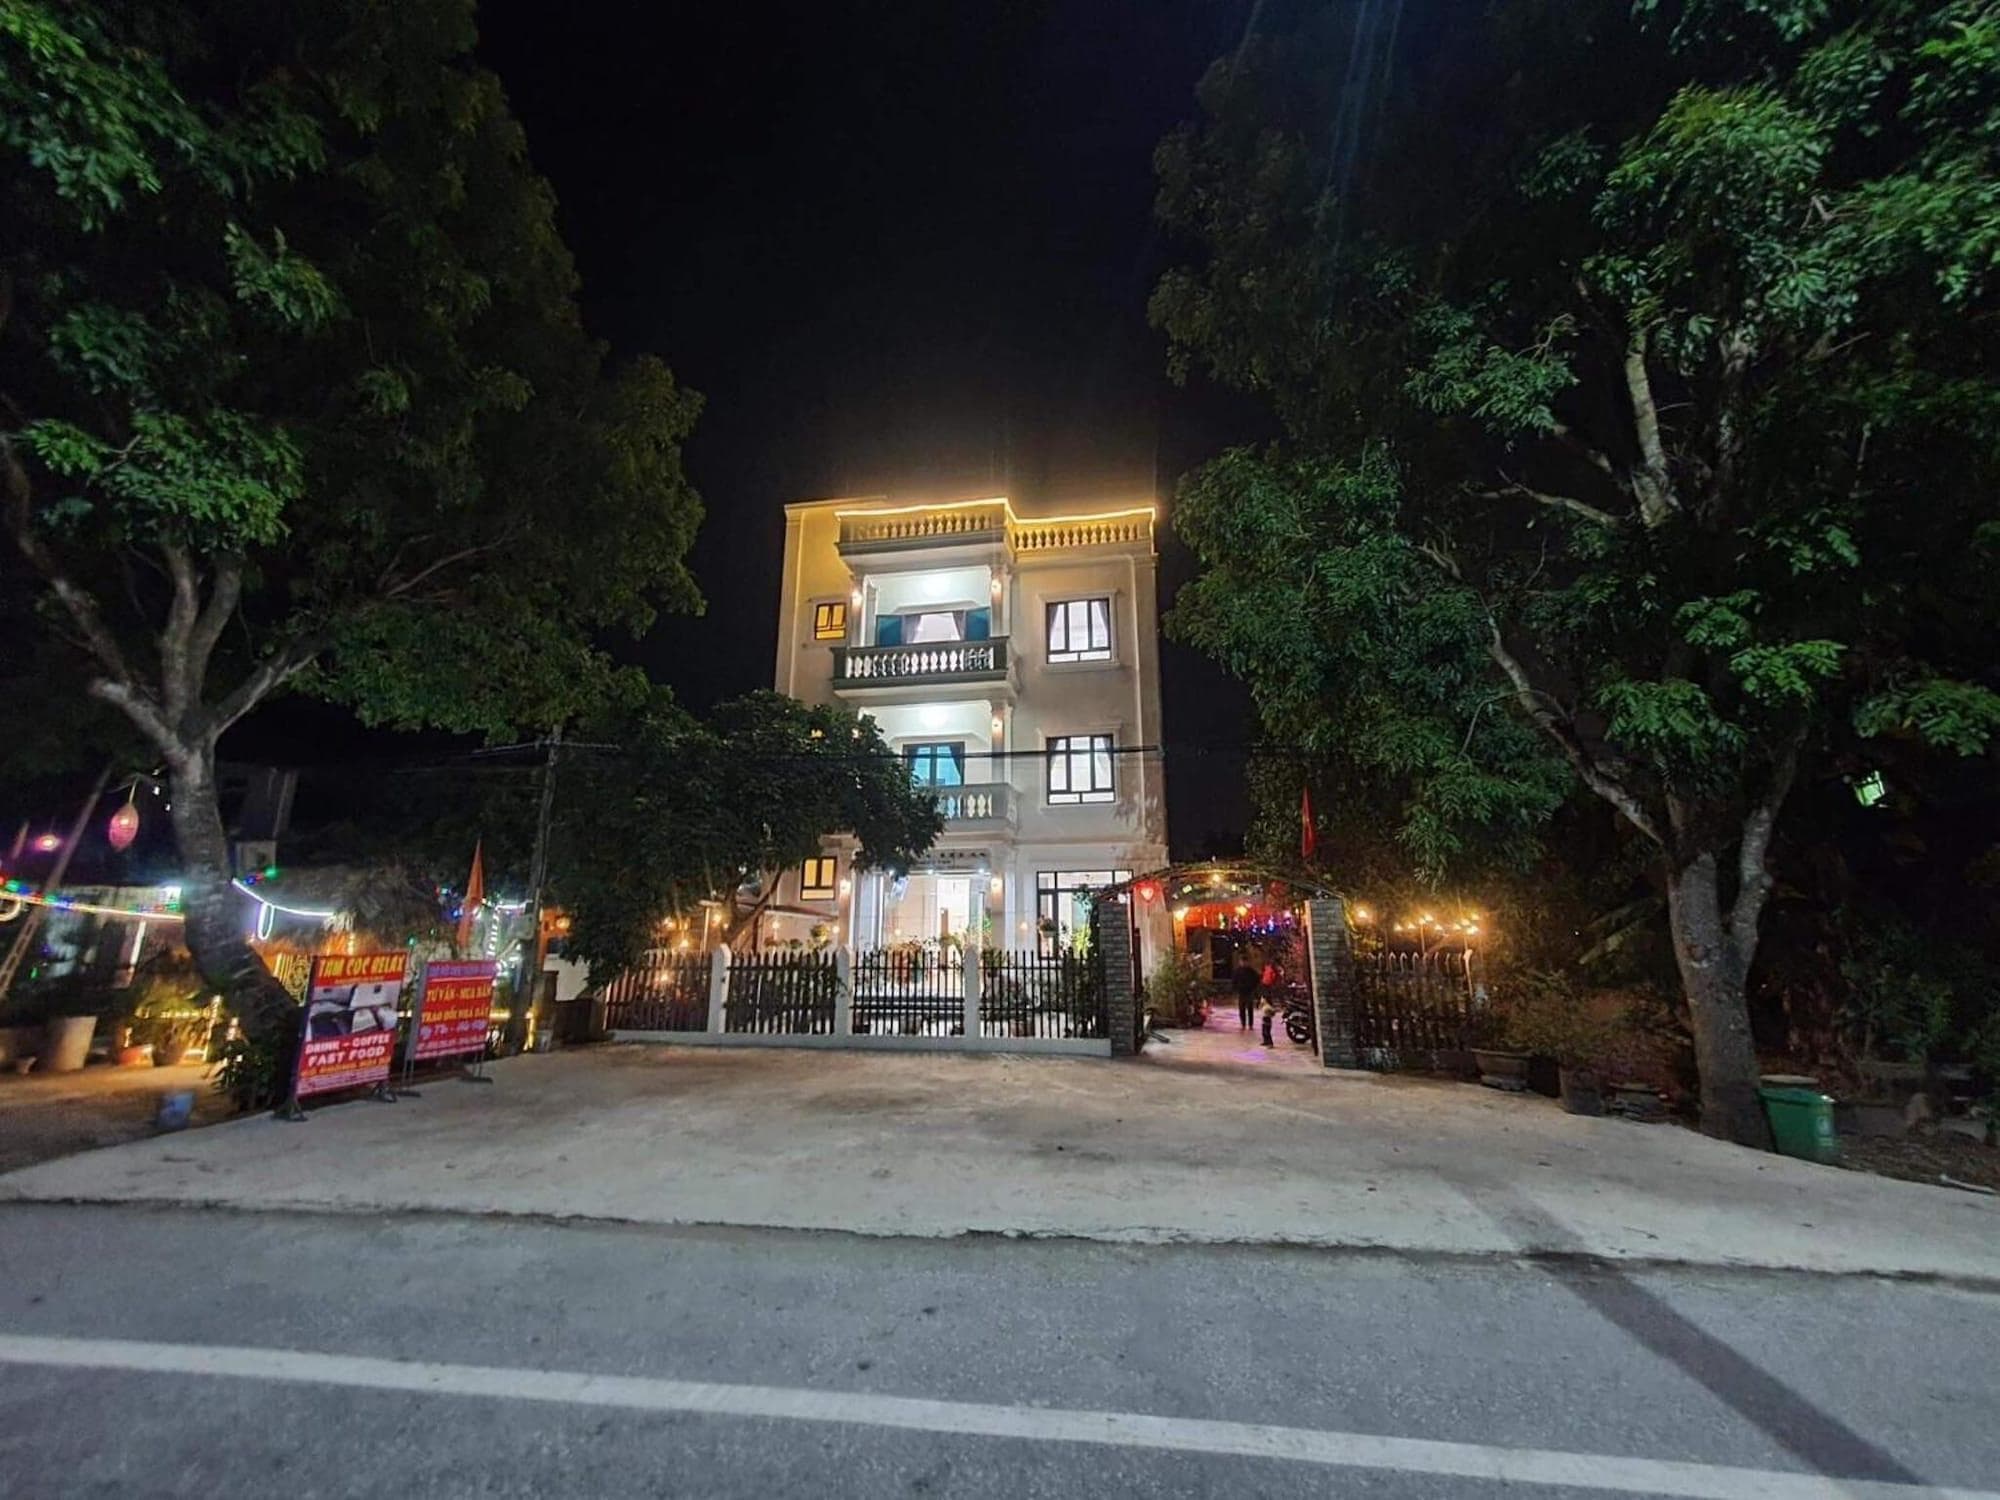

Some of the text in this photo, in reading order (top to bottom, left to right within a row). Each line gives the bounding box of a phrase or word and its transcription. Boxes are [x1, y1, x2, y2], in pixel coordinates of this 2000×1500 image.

[319, 958, 345, 977] TAM
[370, 954, 405, 974] RELAX
[305, 1040, 340, 1055] DRINK
[352, 1033, 391, 1047] COFFEE
[308, 1051, 346, 1067] FAST
[349, 1045, 385, 1061] FOOD
